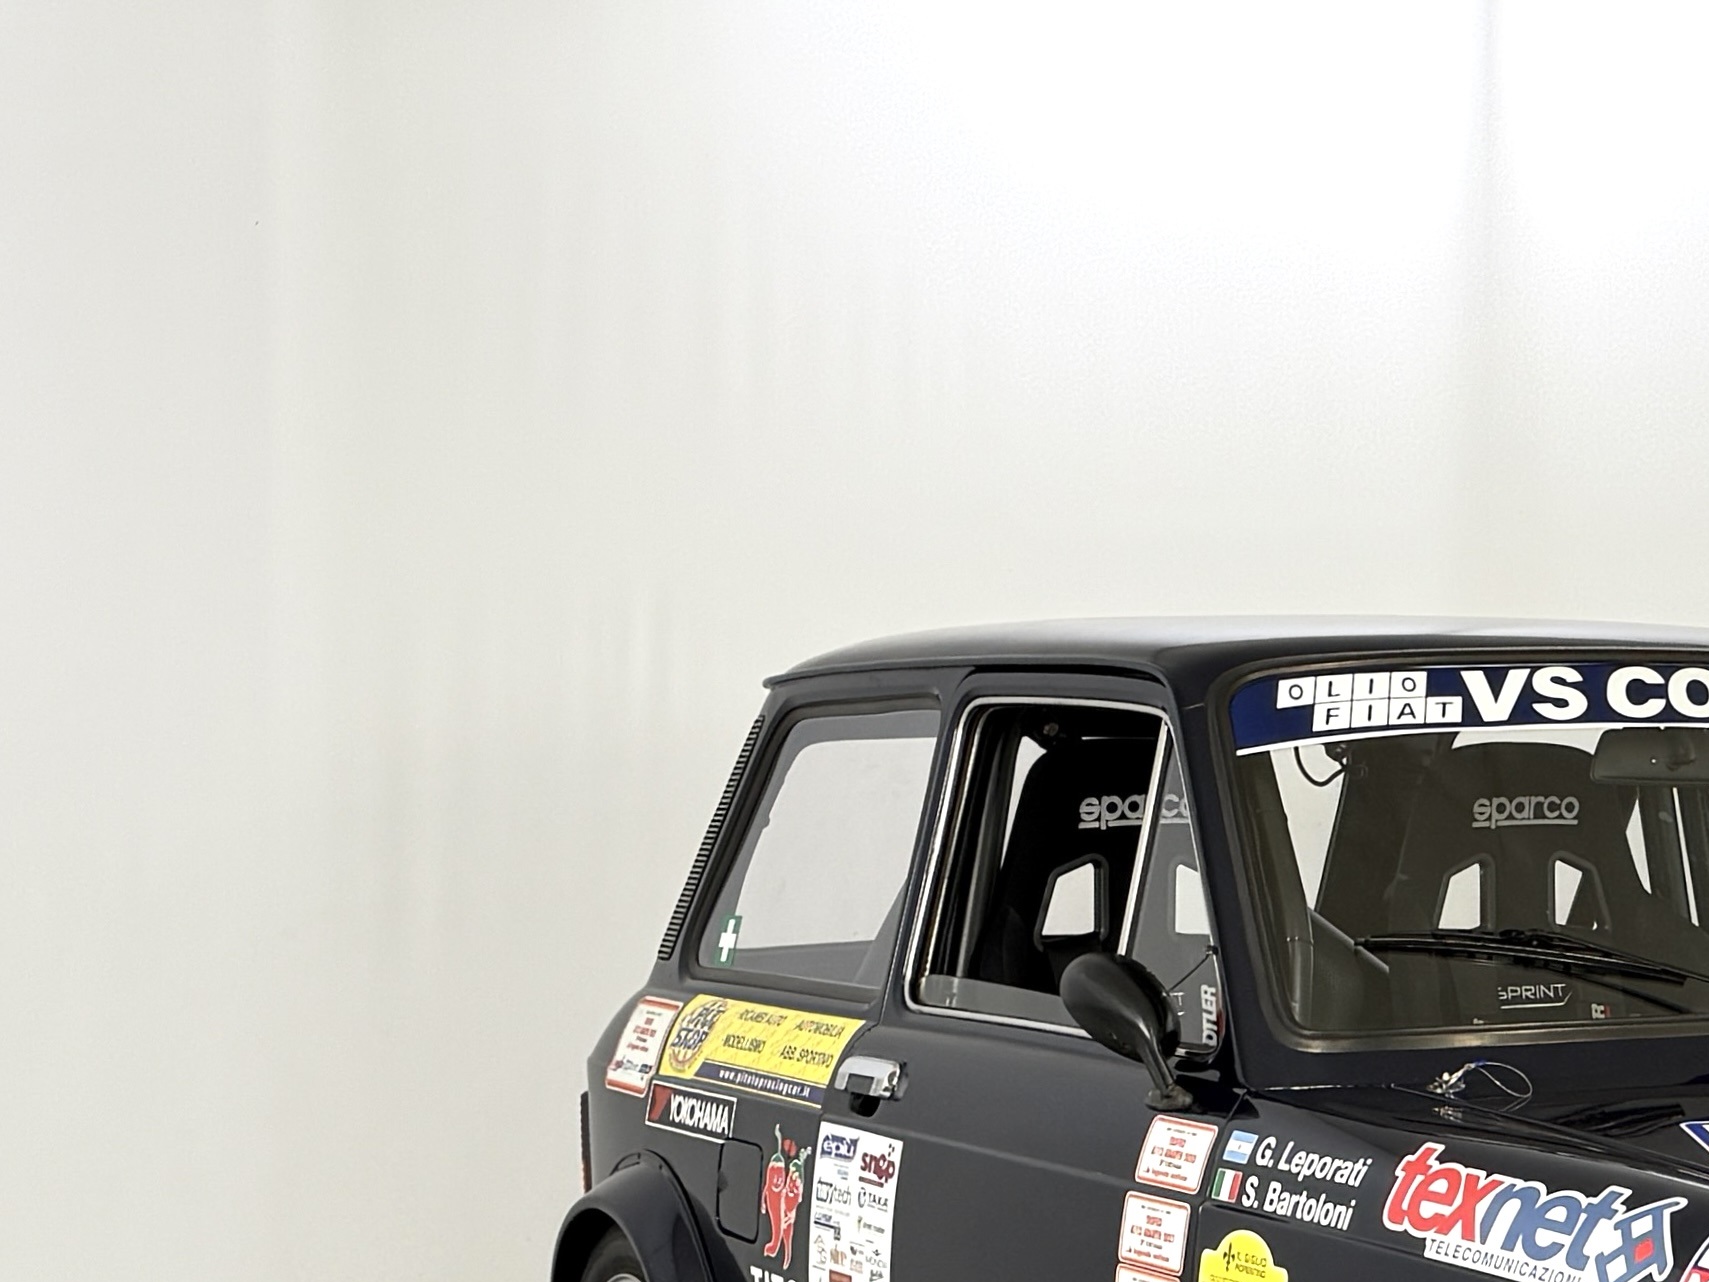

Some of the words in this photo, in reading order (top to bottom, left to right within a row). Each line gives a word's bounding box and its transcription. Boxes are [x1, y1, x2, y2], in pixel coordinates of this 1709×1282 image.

[1286, 675, 1419, 702] OLIO
[1460, 666, 1588, 722] VS
[1323, 699, 1456, 727] FIAT
[1472, 795, 1580, 829] sparco
[1498, 983, 1567, 1001] SPRINT
[669, 1093, 730, 1135] YOKOHAMA
[1255, 1136, 1276, 1168] G.
[1278, 1141, 1373, 1188] Leporati
[1241, 1175, 1260, 1209] S.
[1263, 1180, 1356, 1231] Bartoloni
[1386, 1146, 1628, 1272] texnet
